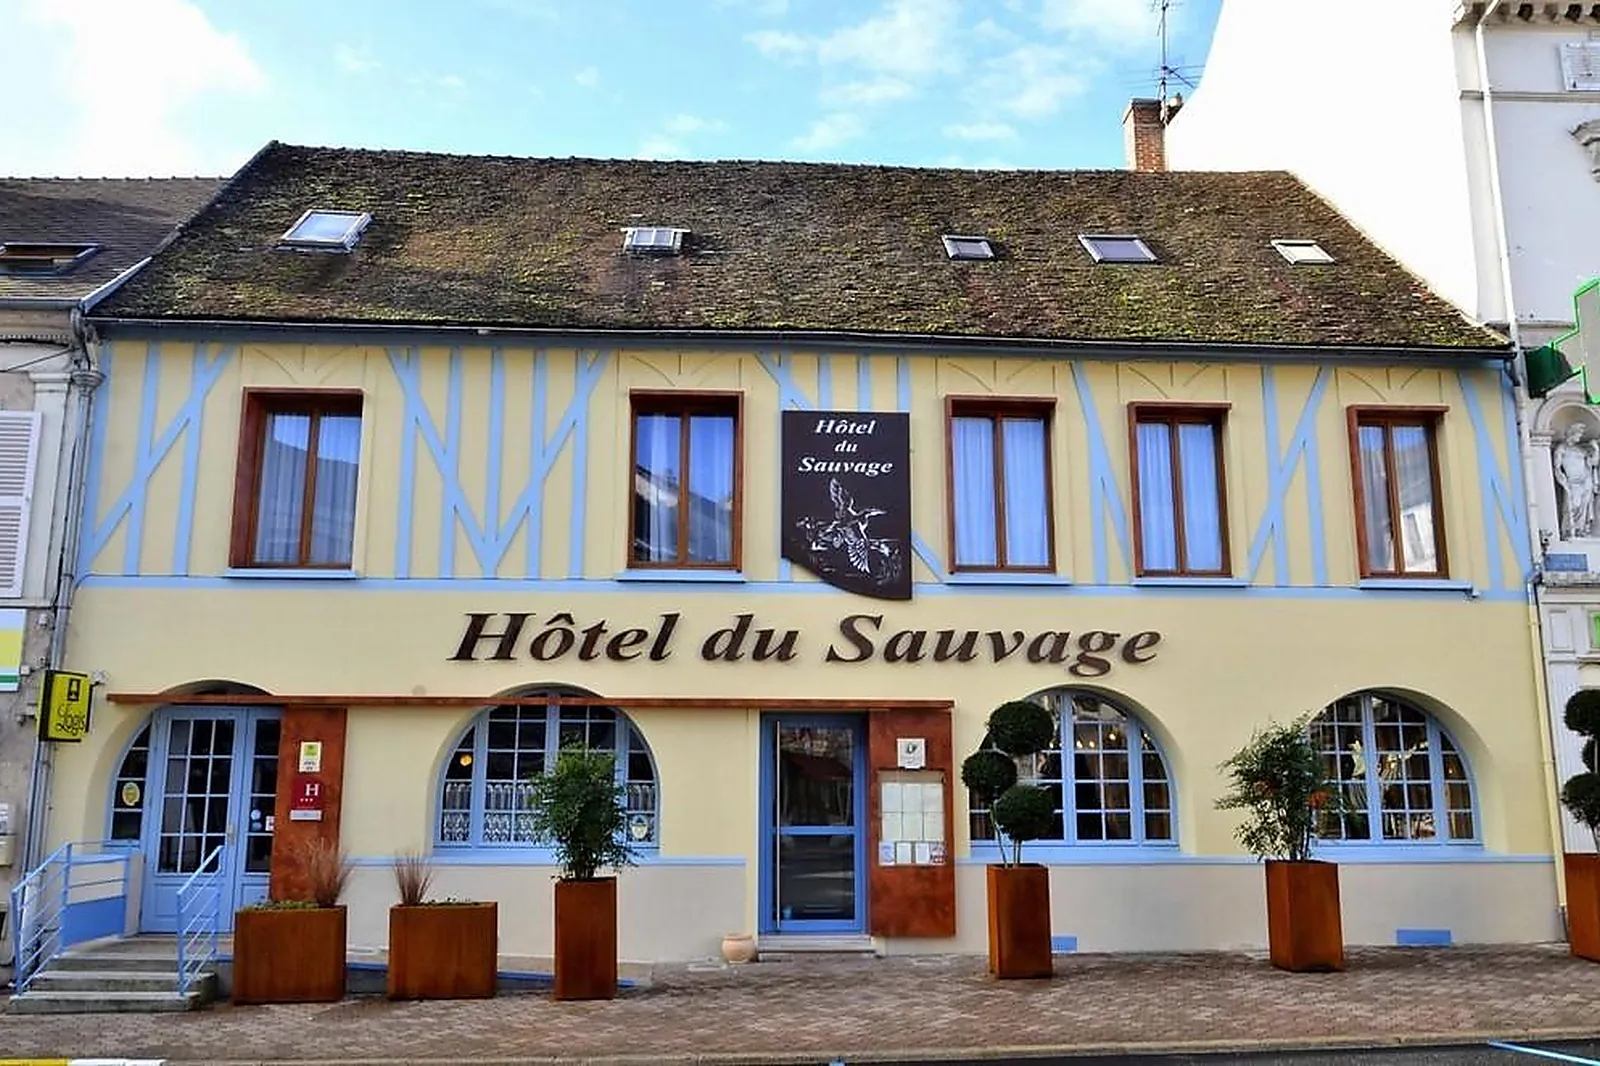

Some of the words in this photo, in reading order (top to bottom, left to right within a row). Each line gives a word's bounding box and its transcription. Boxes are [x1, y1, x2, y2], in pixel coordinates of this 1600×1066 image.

[815, 419, 876, 435] Hôtel
[834, 440, 858, 453] du
[798, 457, 893, 476] Sauvage
[446, 612, 681, 662] Hôtel
[700, 612, 798, 662] du
[825, 614, 1161, 677] Sauvage
[305, 783, 319, 797] H
